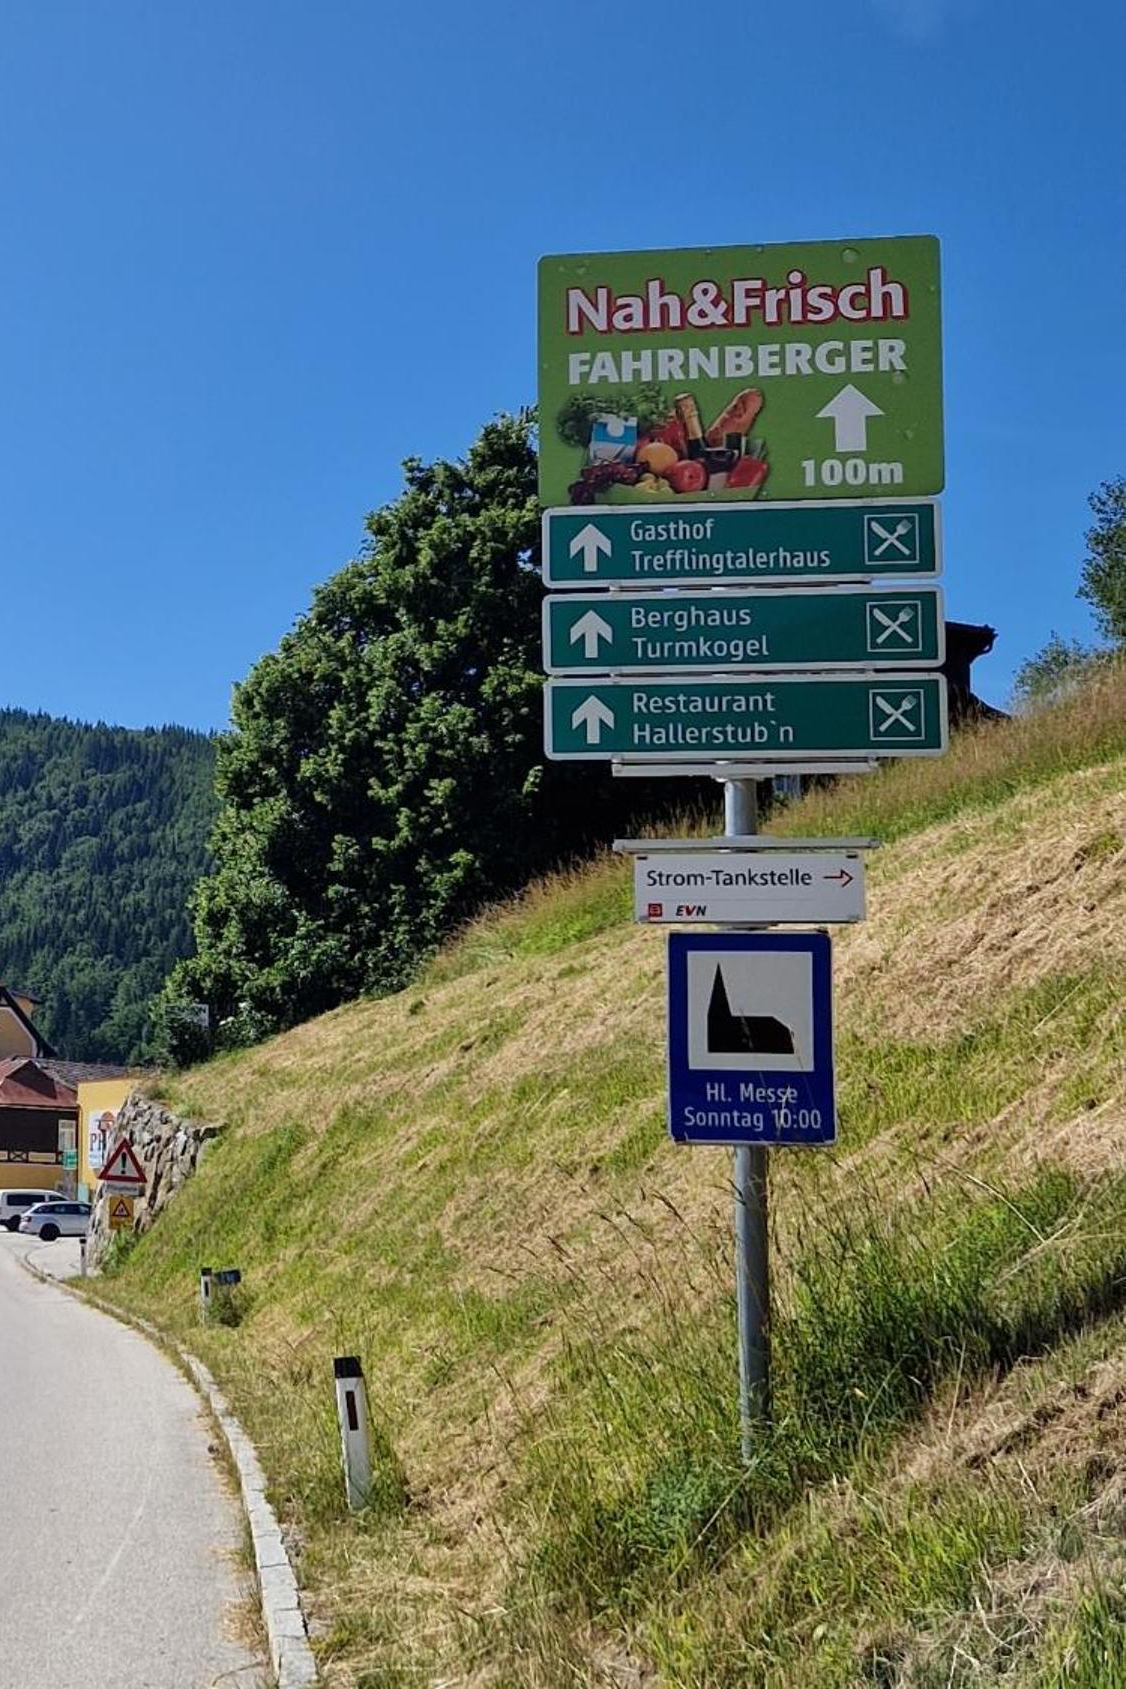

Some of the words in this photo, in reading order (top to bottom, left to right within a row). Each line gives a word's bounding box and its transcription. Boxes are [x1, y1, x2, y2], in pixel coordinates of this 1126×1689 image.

[567, 266, 908, 334] Nah&Frisch
[568, 339, 908, 385] FAHRNBERGER
[802, 458, 904, 487] 100m
[630, 518, 715, 542] Gasthof
[631, 547, 831, 574] Trefflingtalerhaus
[631, 606, 752, 632] Berghaus
[632, 636, 770, 662] Turmkogel
[632, 690, 776, 714] Restaurant
[646, 868, 813, 887] Strom-Tankstelle
[675, 904, 707, 917] EVN
[739, 1082, 798, 1103] Messe
[683, 1107, 764, 1131] Sonntag
[773, 1108, 822, 1130] 10:00
